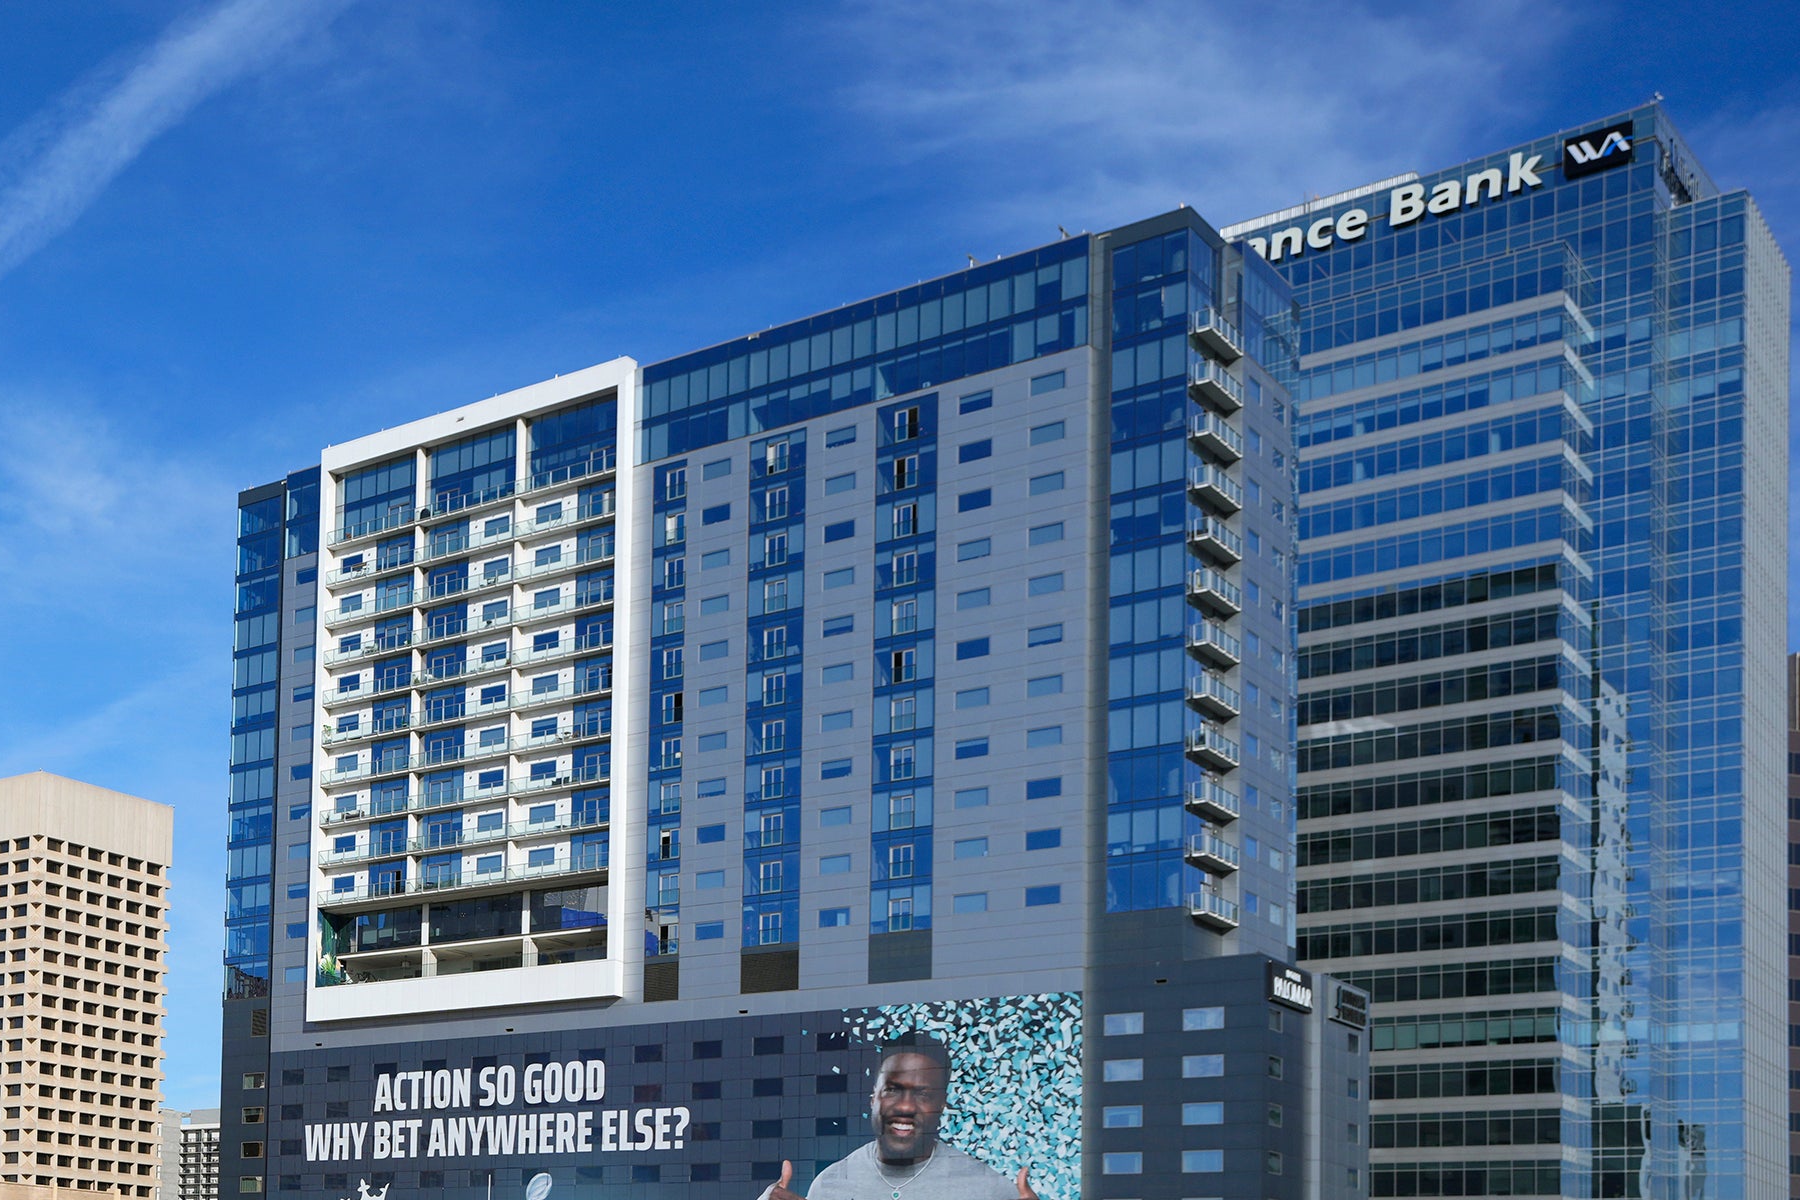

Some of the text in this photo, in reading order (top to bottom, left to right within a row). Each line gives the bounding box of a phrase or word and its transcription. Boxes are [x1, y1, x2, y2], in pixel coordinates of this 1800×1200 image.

[1389, 151, 1543, 227] Bank
[374, 1059, 605, 1112] ACTION SO GOOD
[304, 1106, 690, 1162] WHY BET ANYWHERE ELSE?
